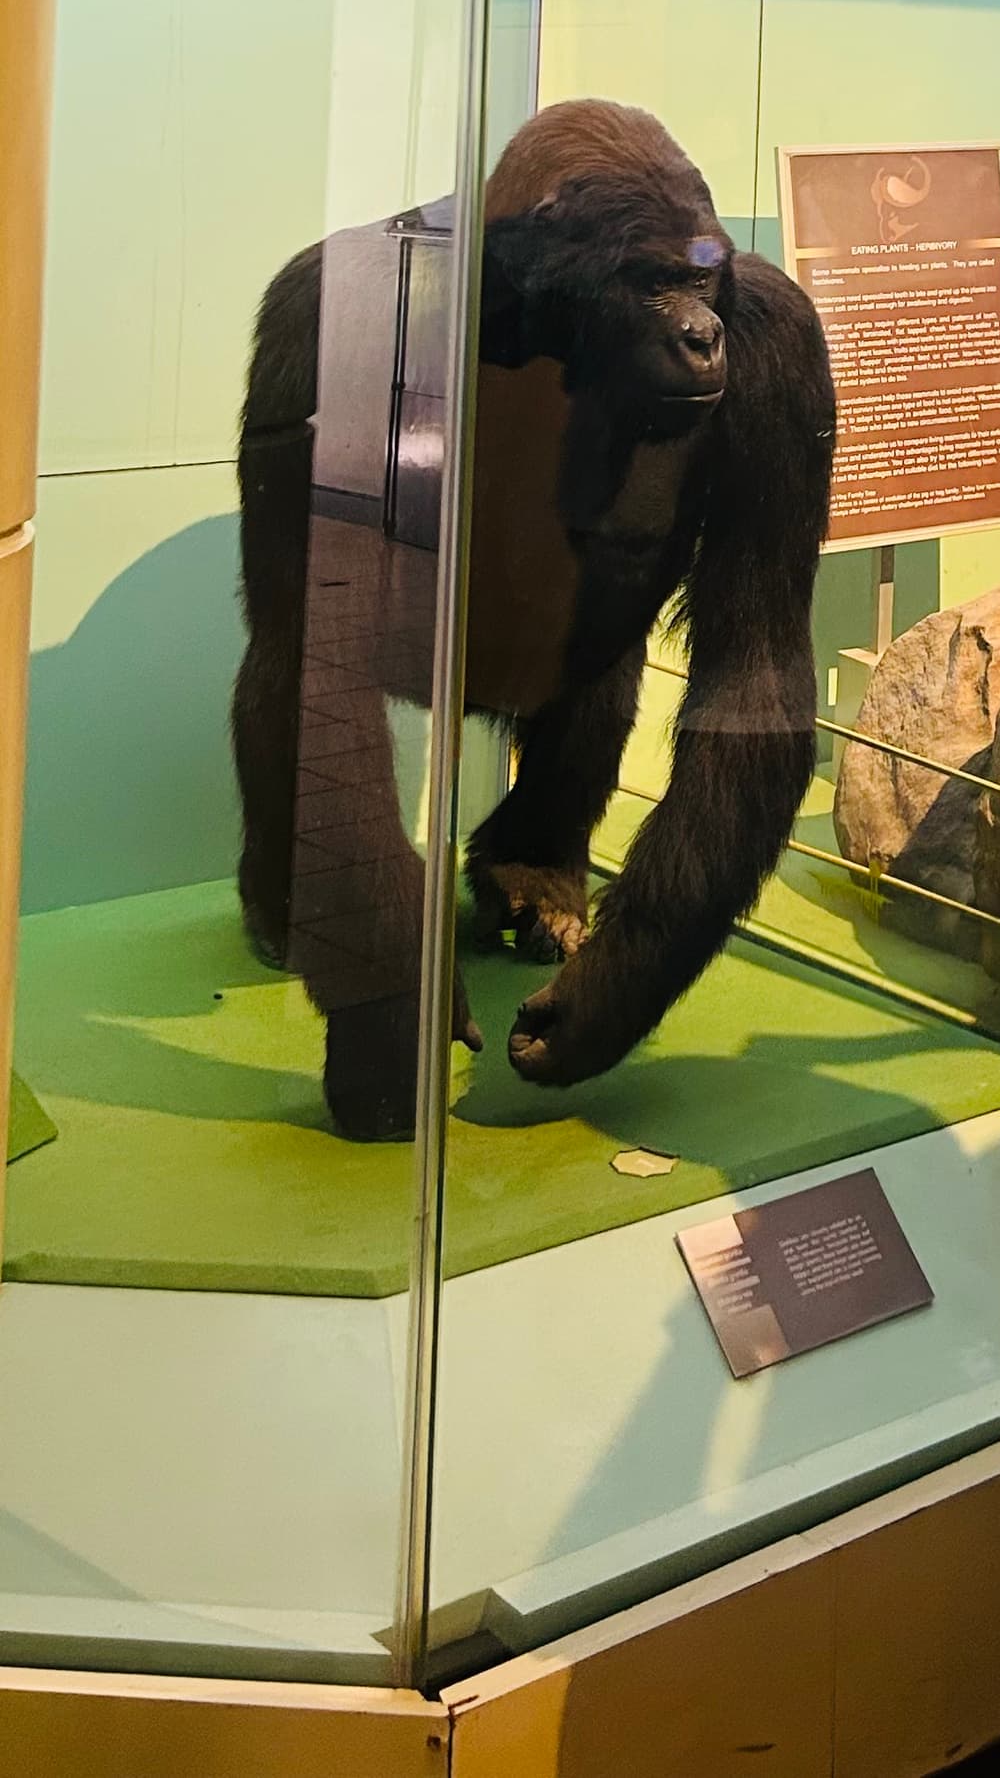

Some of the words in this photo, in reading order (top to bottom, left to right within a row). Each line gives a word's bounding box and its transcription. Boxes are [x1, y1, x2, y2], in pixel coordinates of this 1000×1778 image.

[851, 245, 878, 254] EATING
[879, 243, 908, 252] PLANTS
[915, 240, 956, 250] HERBIVORY
